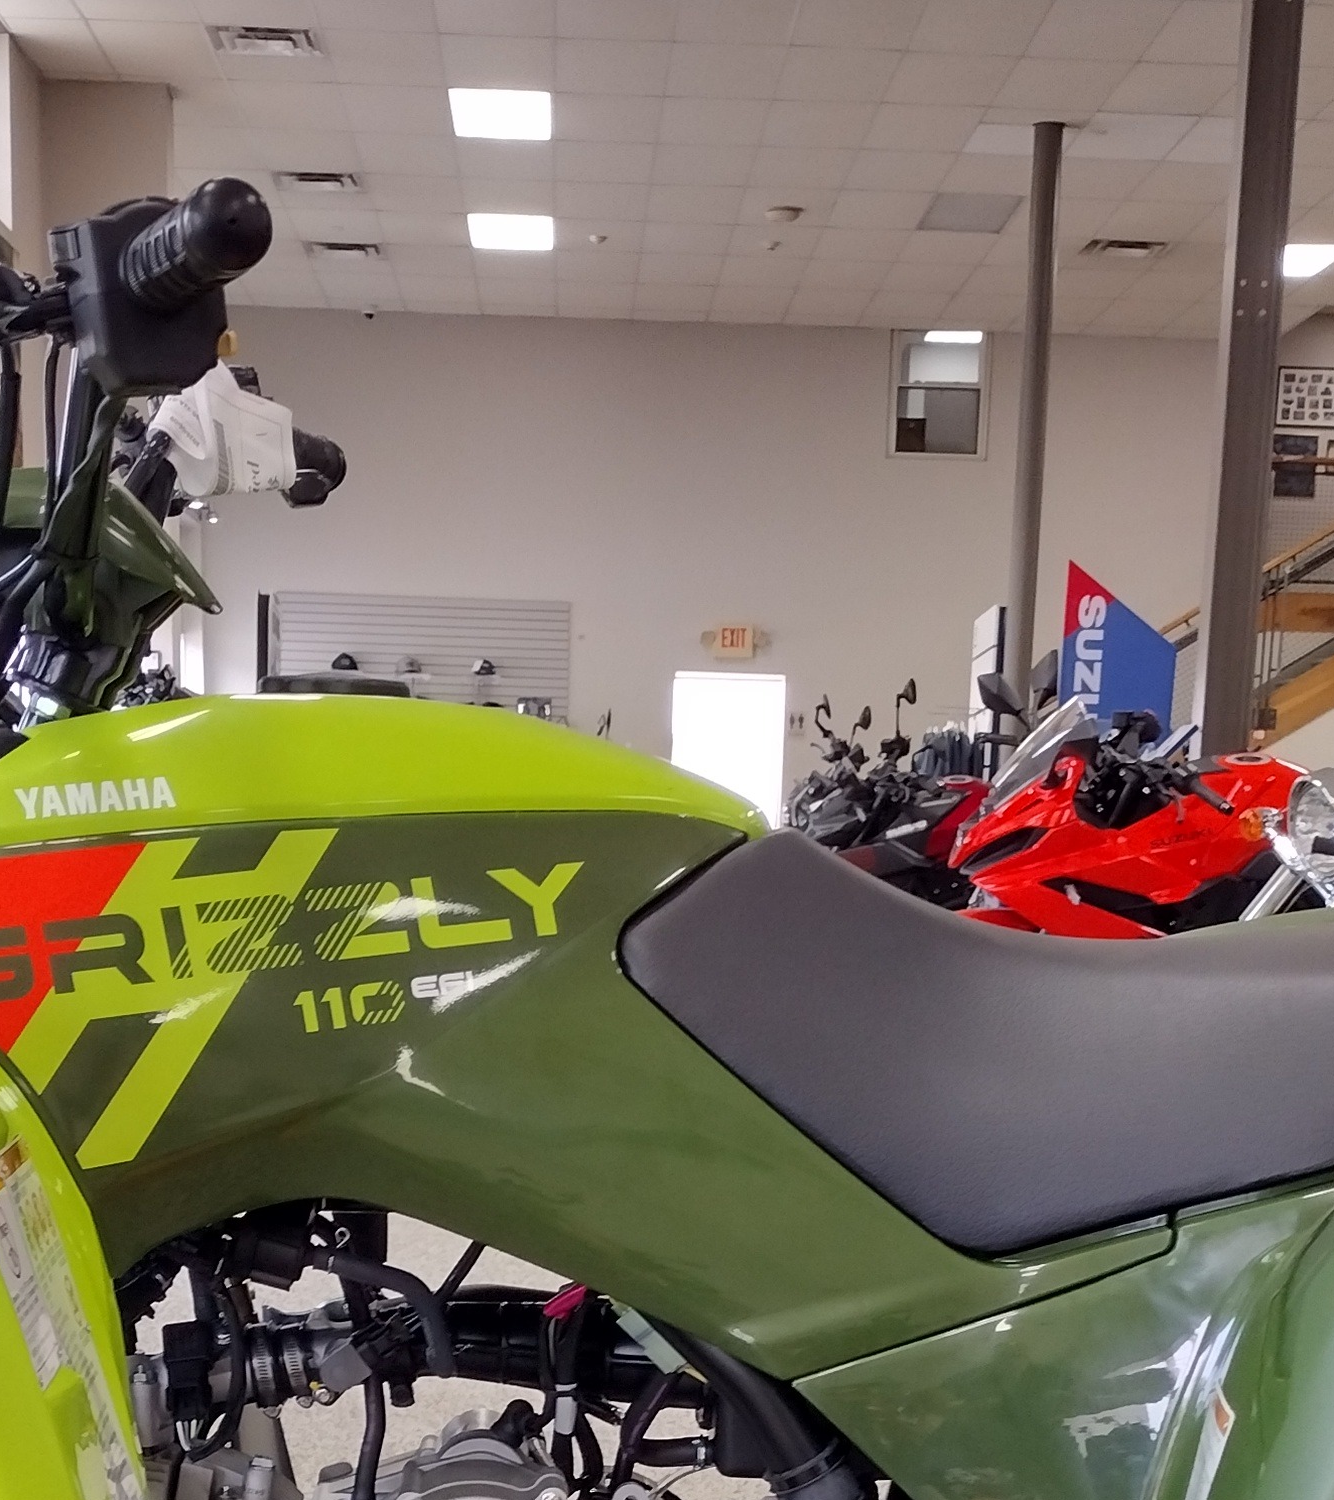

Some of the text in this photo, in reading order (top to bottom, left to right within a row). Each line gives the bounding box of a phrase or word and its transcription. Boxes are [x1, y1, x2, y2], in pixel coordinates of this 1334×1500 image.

[722, 627, 747, 648] EXIT
[14, 776, 177, 819] YAMAHA
[293, 980, 406, 1033] 110
